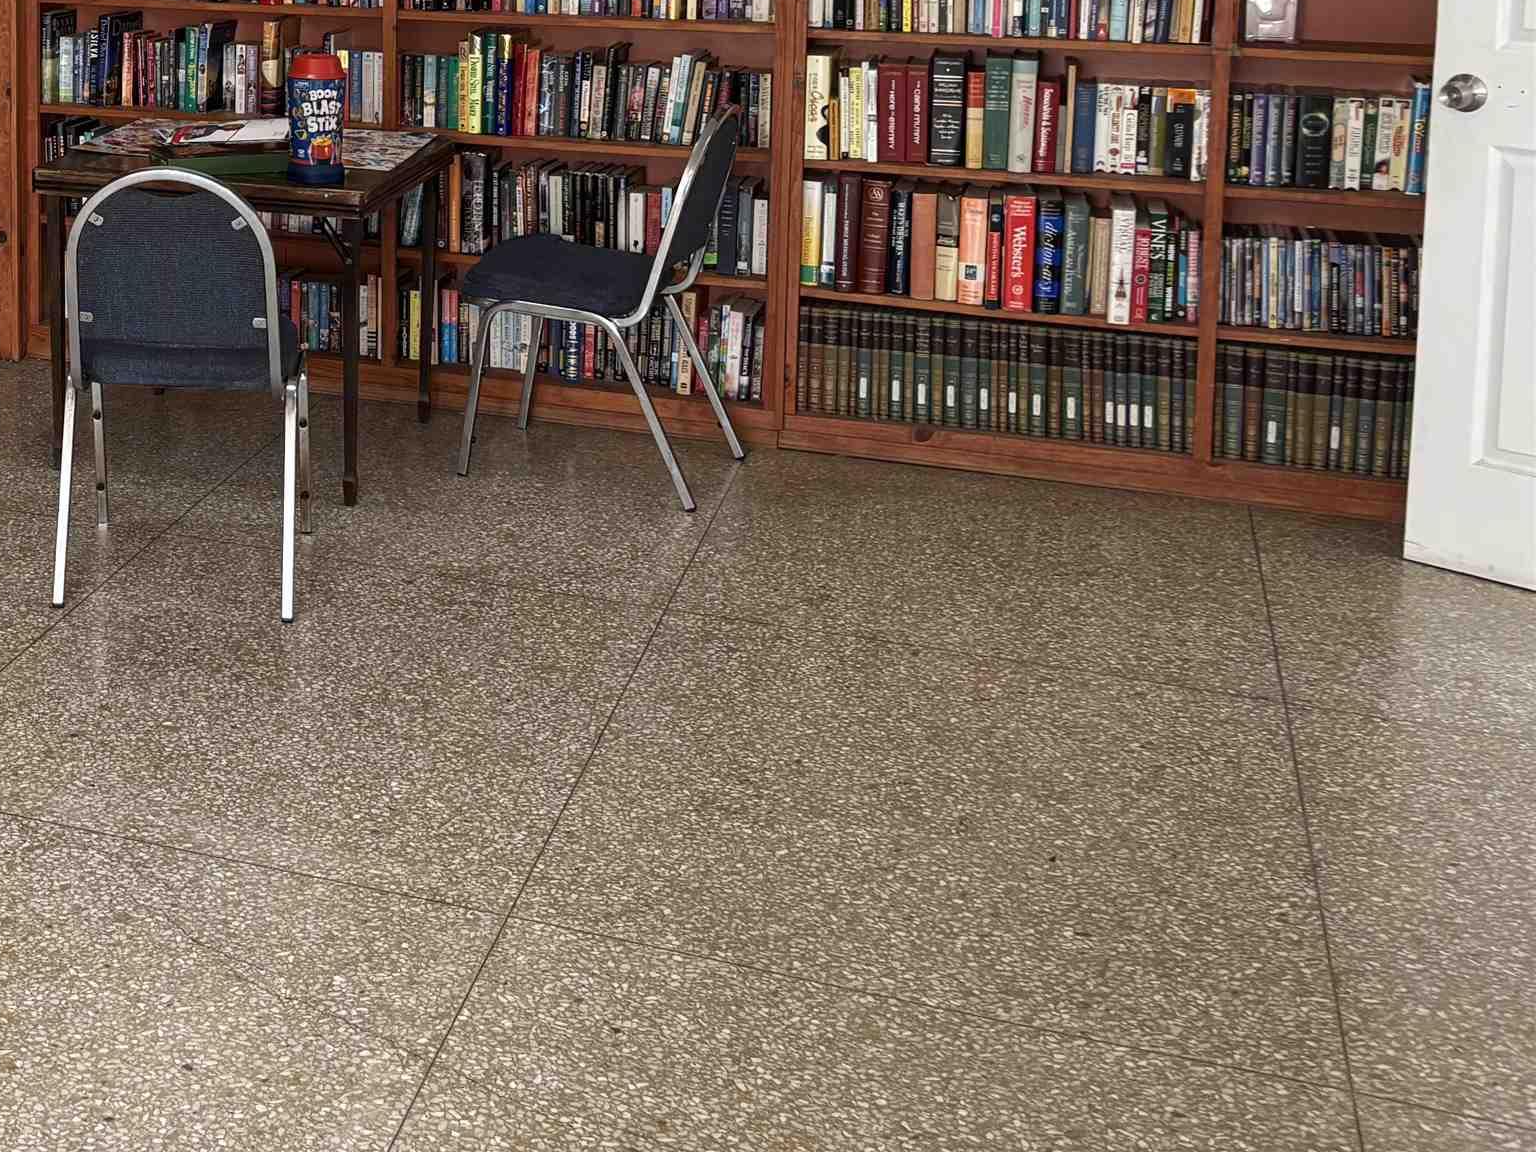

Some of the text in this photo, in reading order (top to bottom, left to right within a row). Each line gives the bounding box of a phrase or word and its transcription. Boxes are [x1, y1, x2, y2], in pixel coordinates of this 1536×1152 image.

[89, 34, 99, 59] SILVA
[309, 89, 338, 101] BOOM
[301, 99, 342, 117] BLAST
[1011, 225, 1026, 278] Webster's
